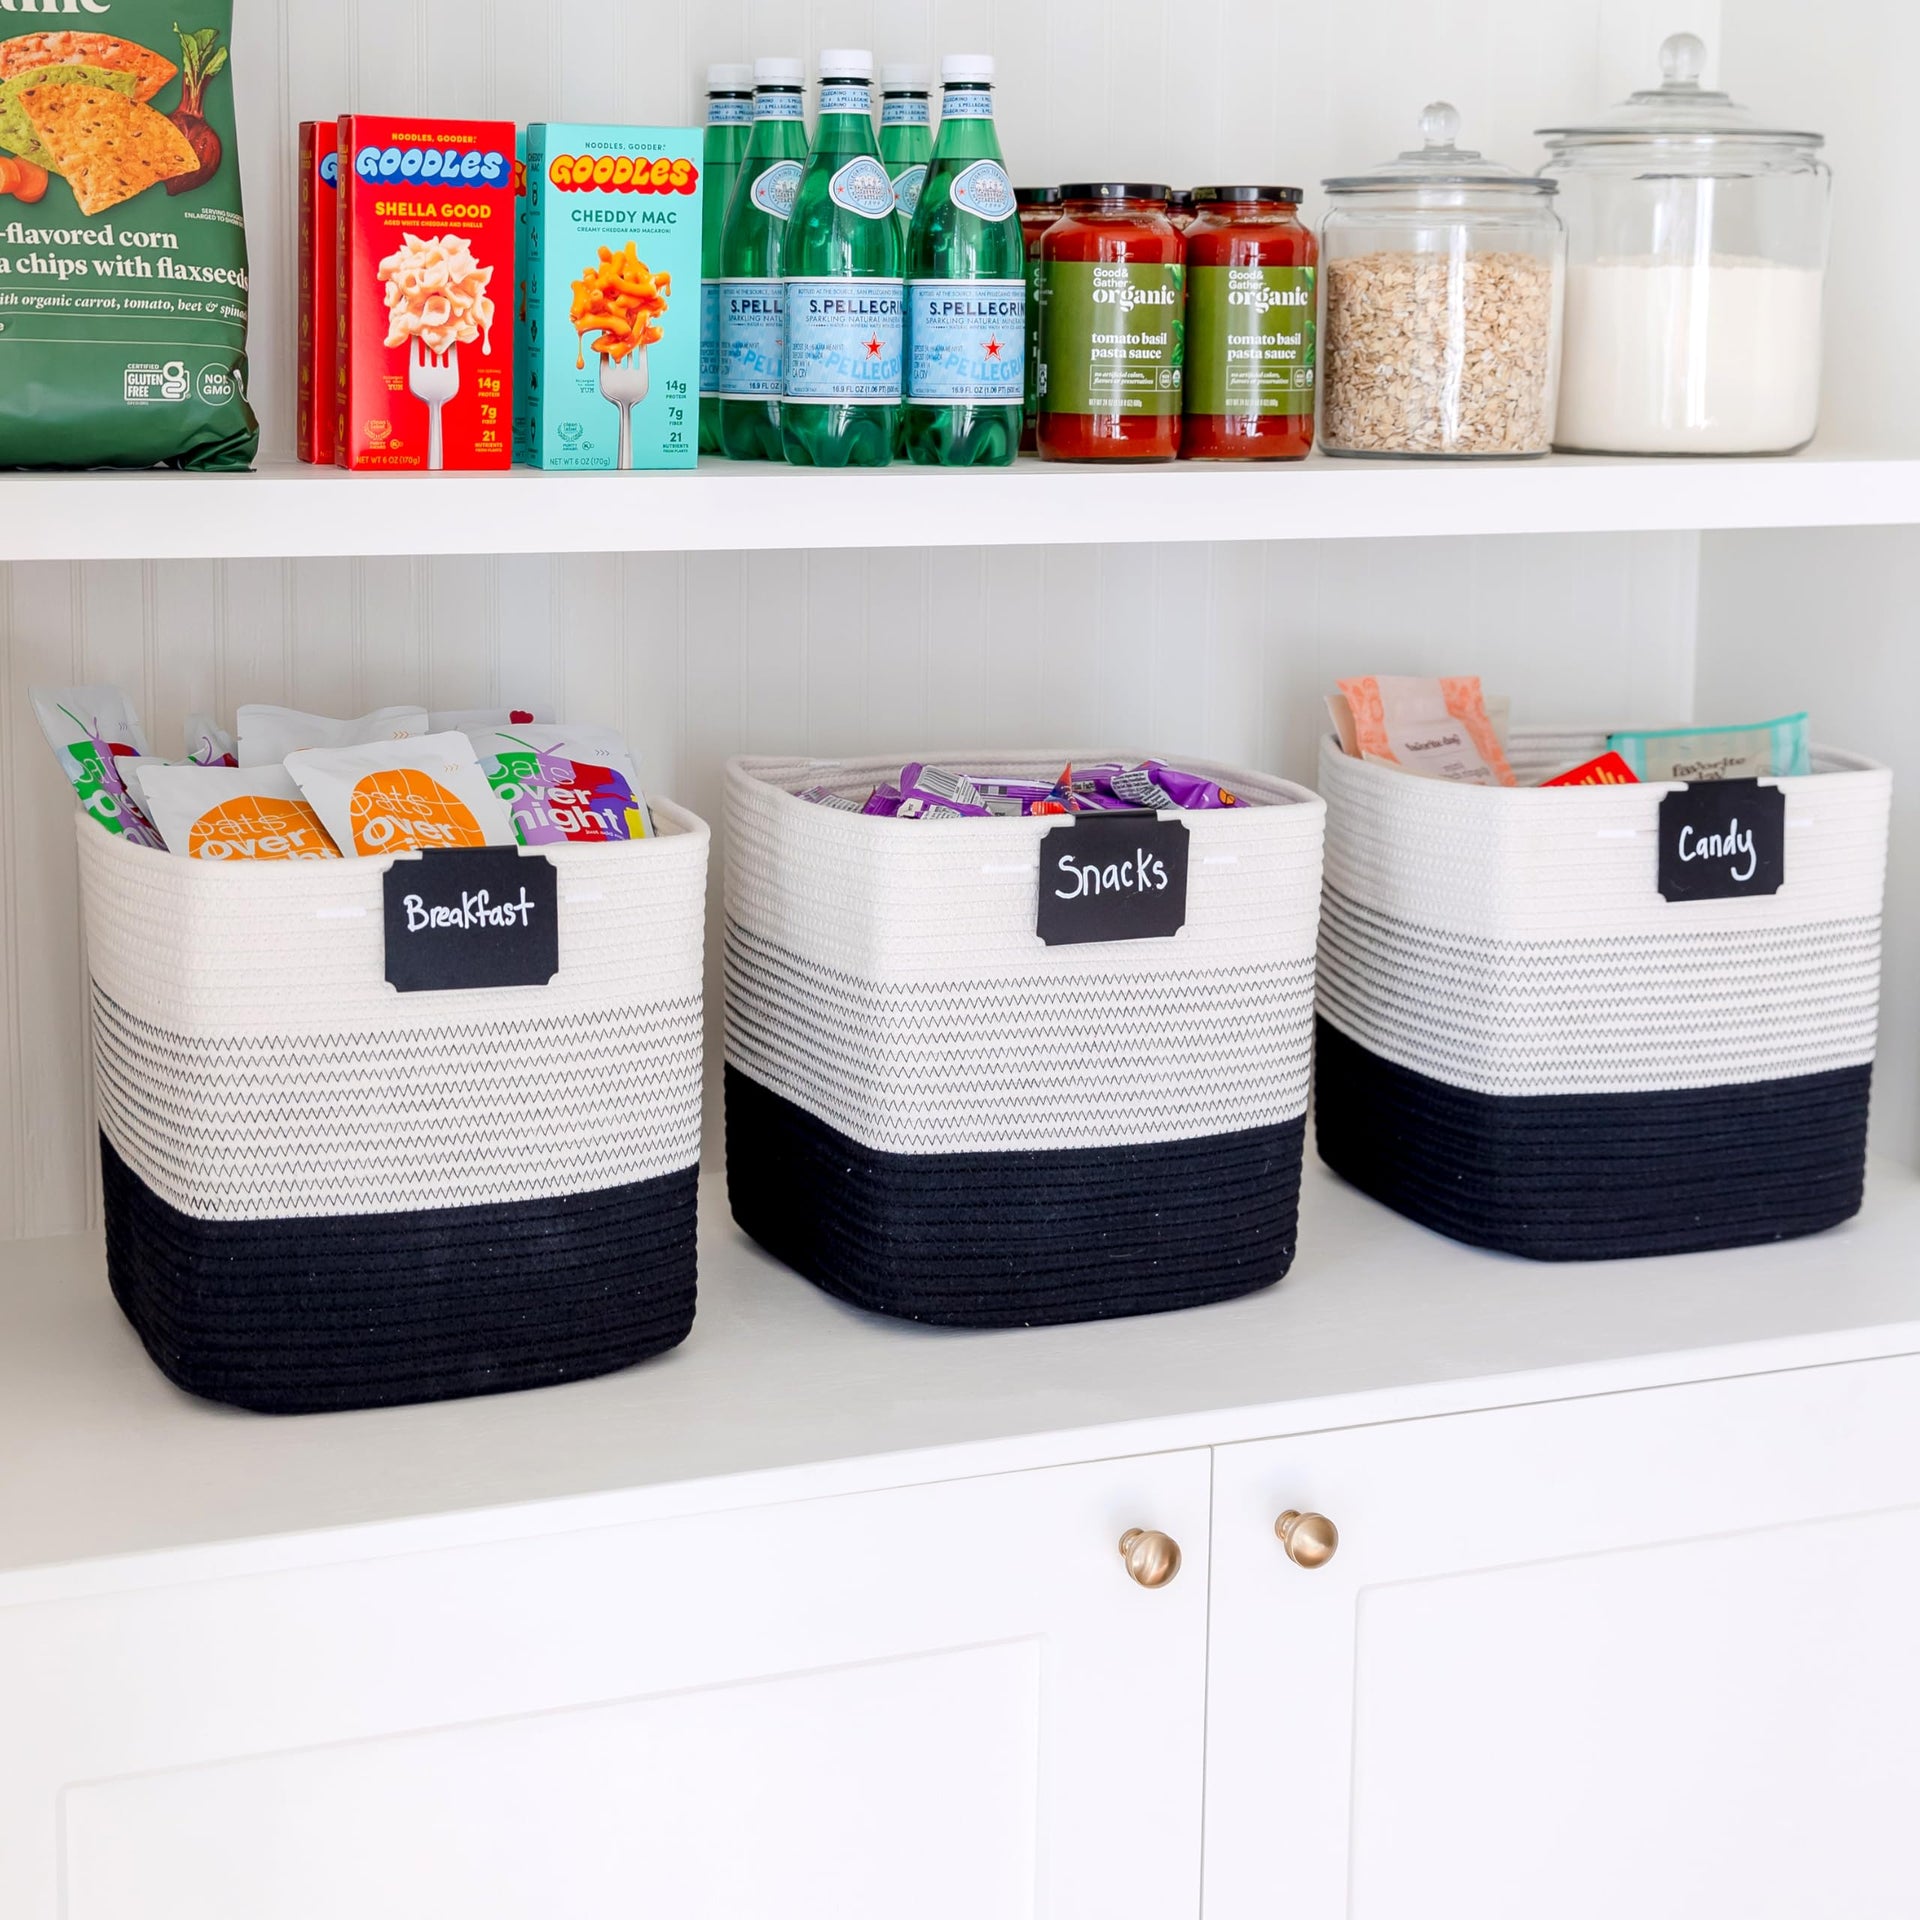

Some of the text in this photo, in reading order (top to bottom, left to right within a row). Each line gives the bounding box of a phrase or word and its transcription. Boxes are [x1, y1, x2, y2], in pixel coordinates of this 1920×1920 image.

[392, 133, 435, 142] NOODLES,
[585, 142, 626, 150] NOODLES,
[184, 212, 216, 221] ENLARGED
[375, 202, 491, 218] SHELLA GOOD
[571, 209, 677, 224] CHEDDY MAC
[119, 230, 179, 250] corn
[16, 252, 88, 281] chips
[92, 255, 152, 279] with
[1092, 277, 1129, 288] Gather
[1228, 280, 1263, 290] Gather
[21, 294, 72, 310] organic
[75, 296, 121, 310] carrot,
[124, 298, 175, 312] tomato,
[178, 299, 203, 312] beet
[205, 301, 219, 313] &
[1092, 284, 1175, 312] organic
[1228, 286, 1308, 314] organic
[806, 315, 881, 323] SPARKLING NATURAL
[925, 317, 1000, 325] SPARKLING NATURAL
[1091, 332, 1167, 345] tomato basil
[1227, 333, 1302, 346] tomato basil
[1091, 347, 1162, 361] pasta sauce
[1227, 348, 1297, 362] pasta sauce
[128, 373, 163, 386] GLUTEN
[478, 377, 500, 392] 14g
[665, 380, 687, 394] 14g
[128, 386, 149, 398] FREE
[203, 385, 231, 395] GMO
[481, 404, 497, 419] 7g
[668, 406, 683, 421] 7g
[482, 430, 496, 442] 21
[670, 432, 682, 442] 21
[357, 455, 369, 464] NET
[371, 456, 381, 464] WT
[388, 456, 399, 464] OZ
[400, 456, 421, 466] (170g)
[590, 457, 611, 466] (170g)
[487, 758, 576, 786] oats
[349, 785, 434, 817] oats
[493, 781, 592, 806] over
[189, 813, 288, 836] oats
[508, 801, 624, 838] night
[362, 815, 457, 847] over
[200, 828, 307, 860] over
[1679, 818, 1757, 881] Candy
[1055, 847, 1168, 899] Snacks
[403, 886, 535, 933] Breakfast
